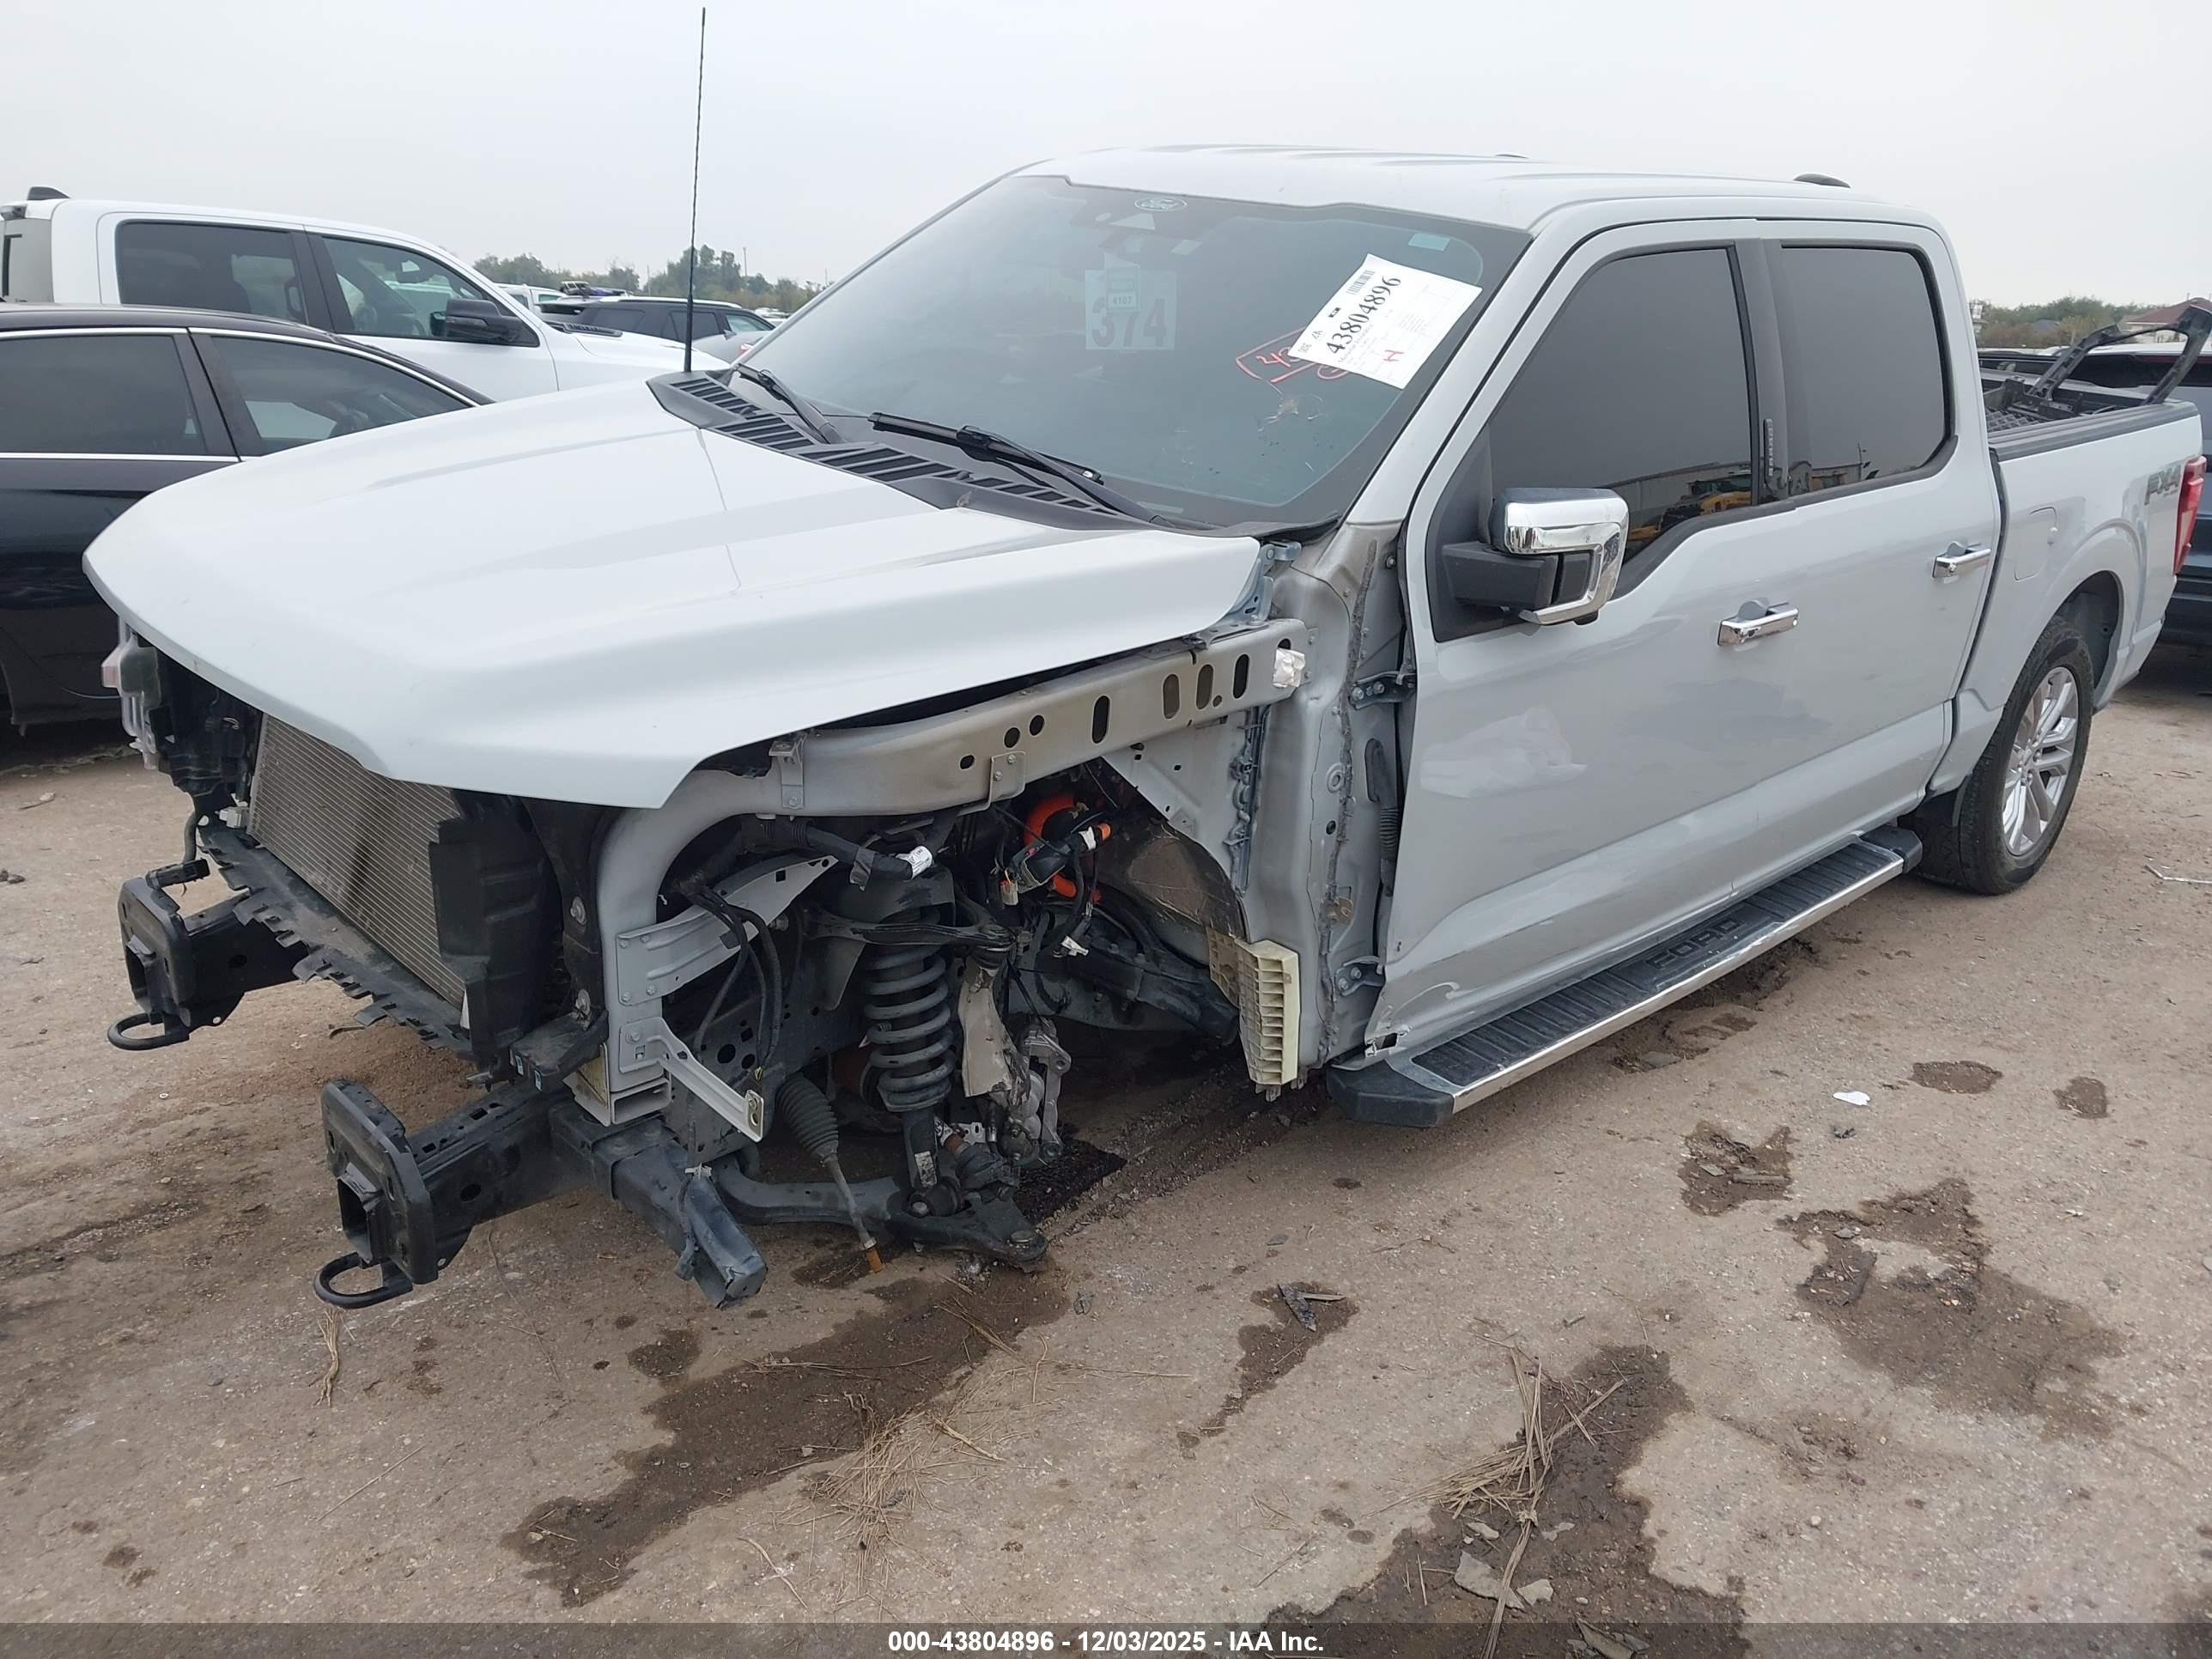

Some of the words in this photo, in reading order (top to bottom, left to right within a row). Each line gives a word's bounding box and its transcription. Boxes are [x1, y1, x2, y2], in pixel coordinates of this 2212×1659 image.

[1326, 276, 1401, 354] 43804896
[2144, 465, 2181, 506] FX4
[1646, 918, 1746, 969] FORD
